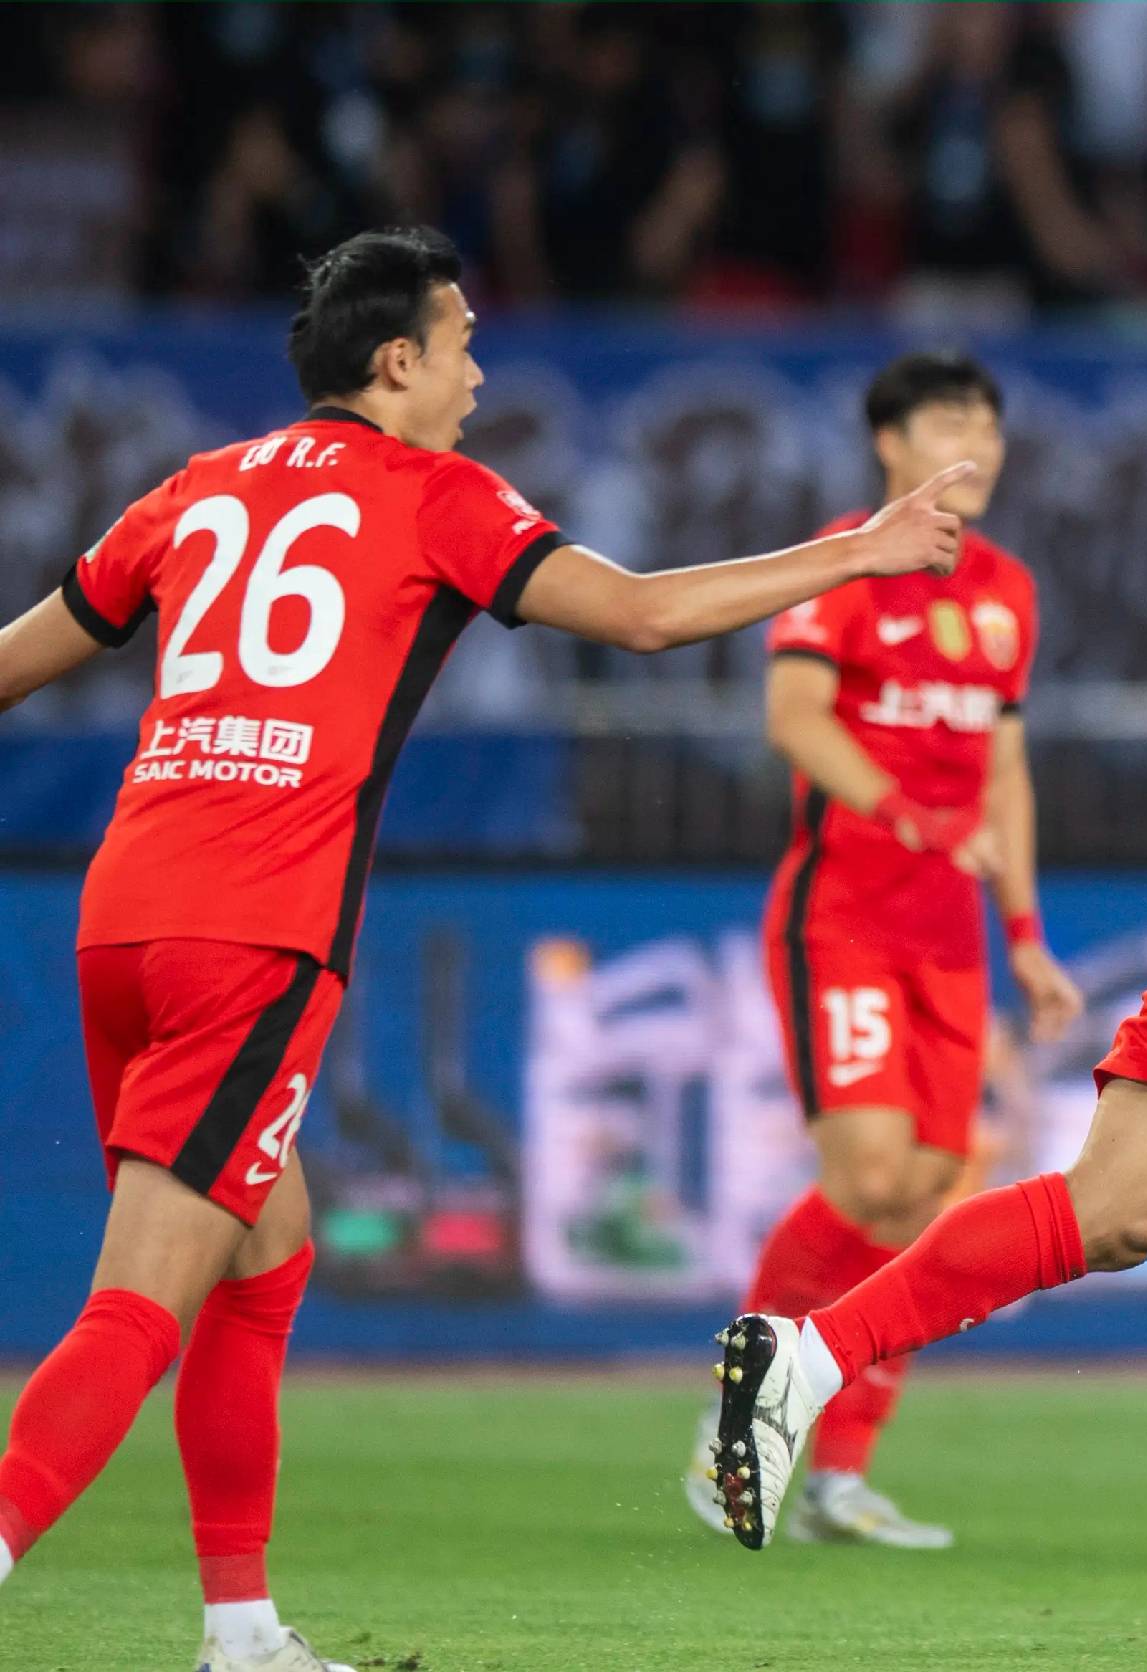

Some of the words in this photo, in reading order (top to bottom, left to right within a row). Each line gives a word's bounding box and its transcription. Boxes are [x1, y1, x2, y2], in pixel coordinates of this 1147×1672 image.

[286, 436, 346, 468] R.F.
[160, 491, 361, 700] 26
[139, 715, 314, 765] 上汽集团
[131, 760, 186, 784] SAIC
[188, 760, 303, 788] MOTOR
[823, 987, 892, 1060] 15
